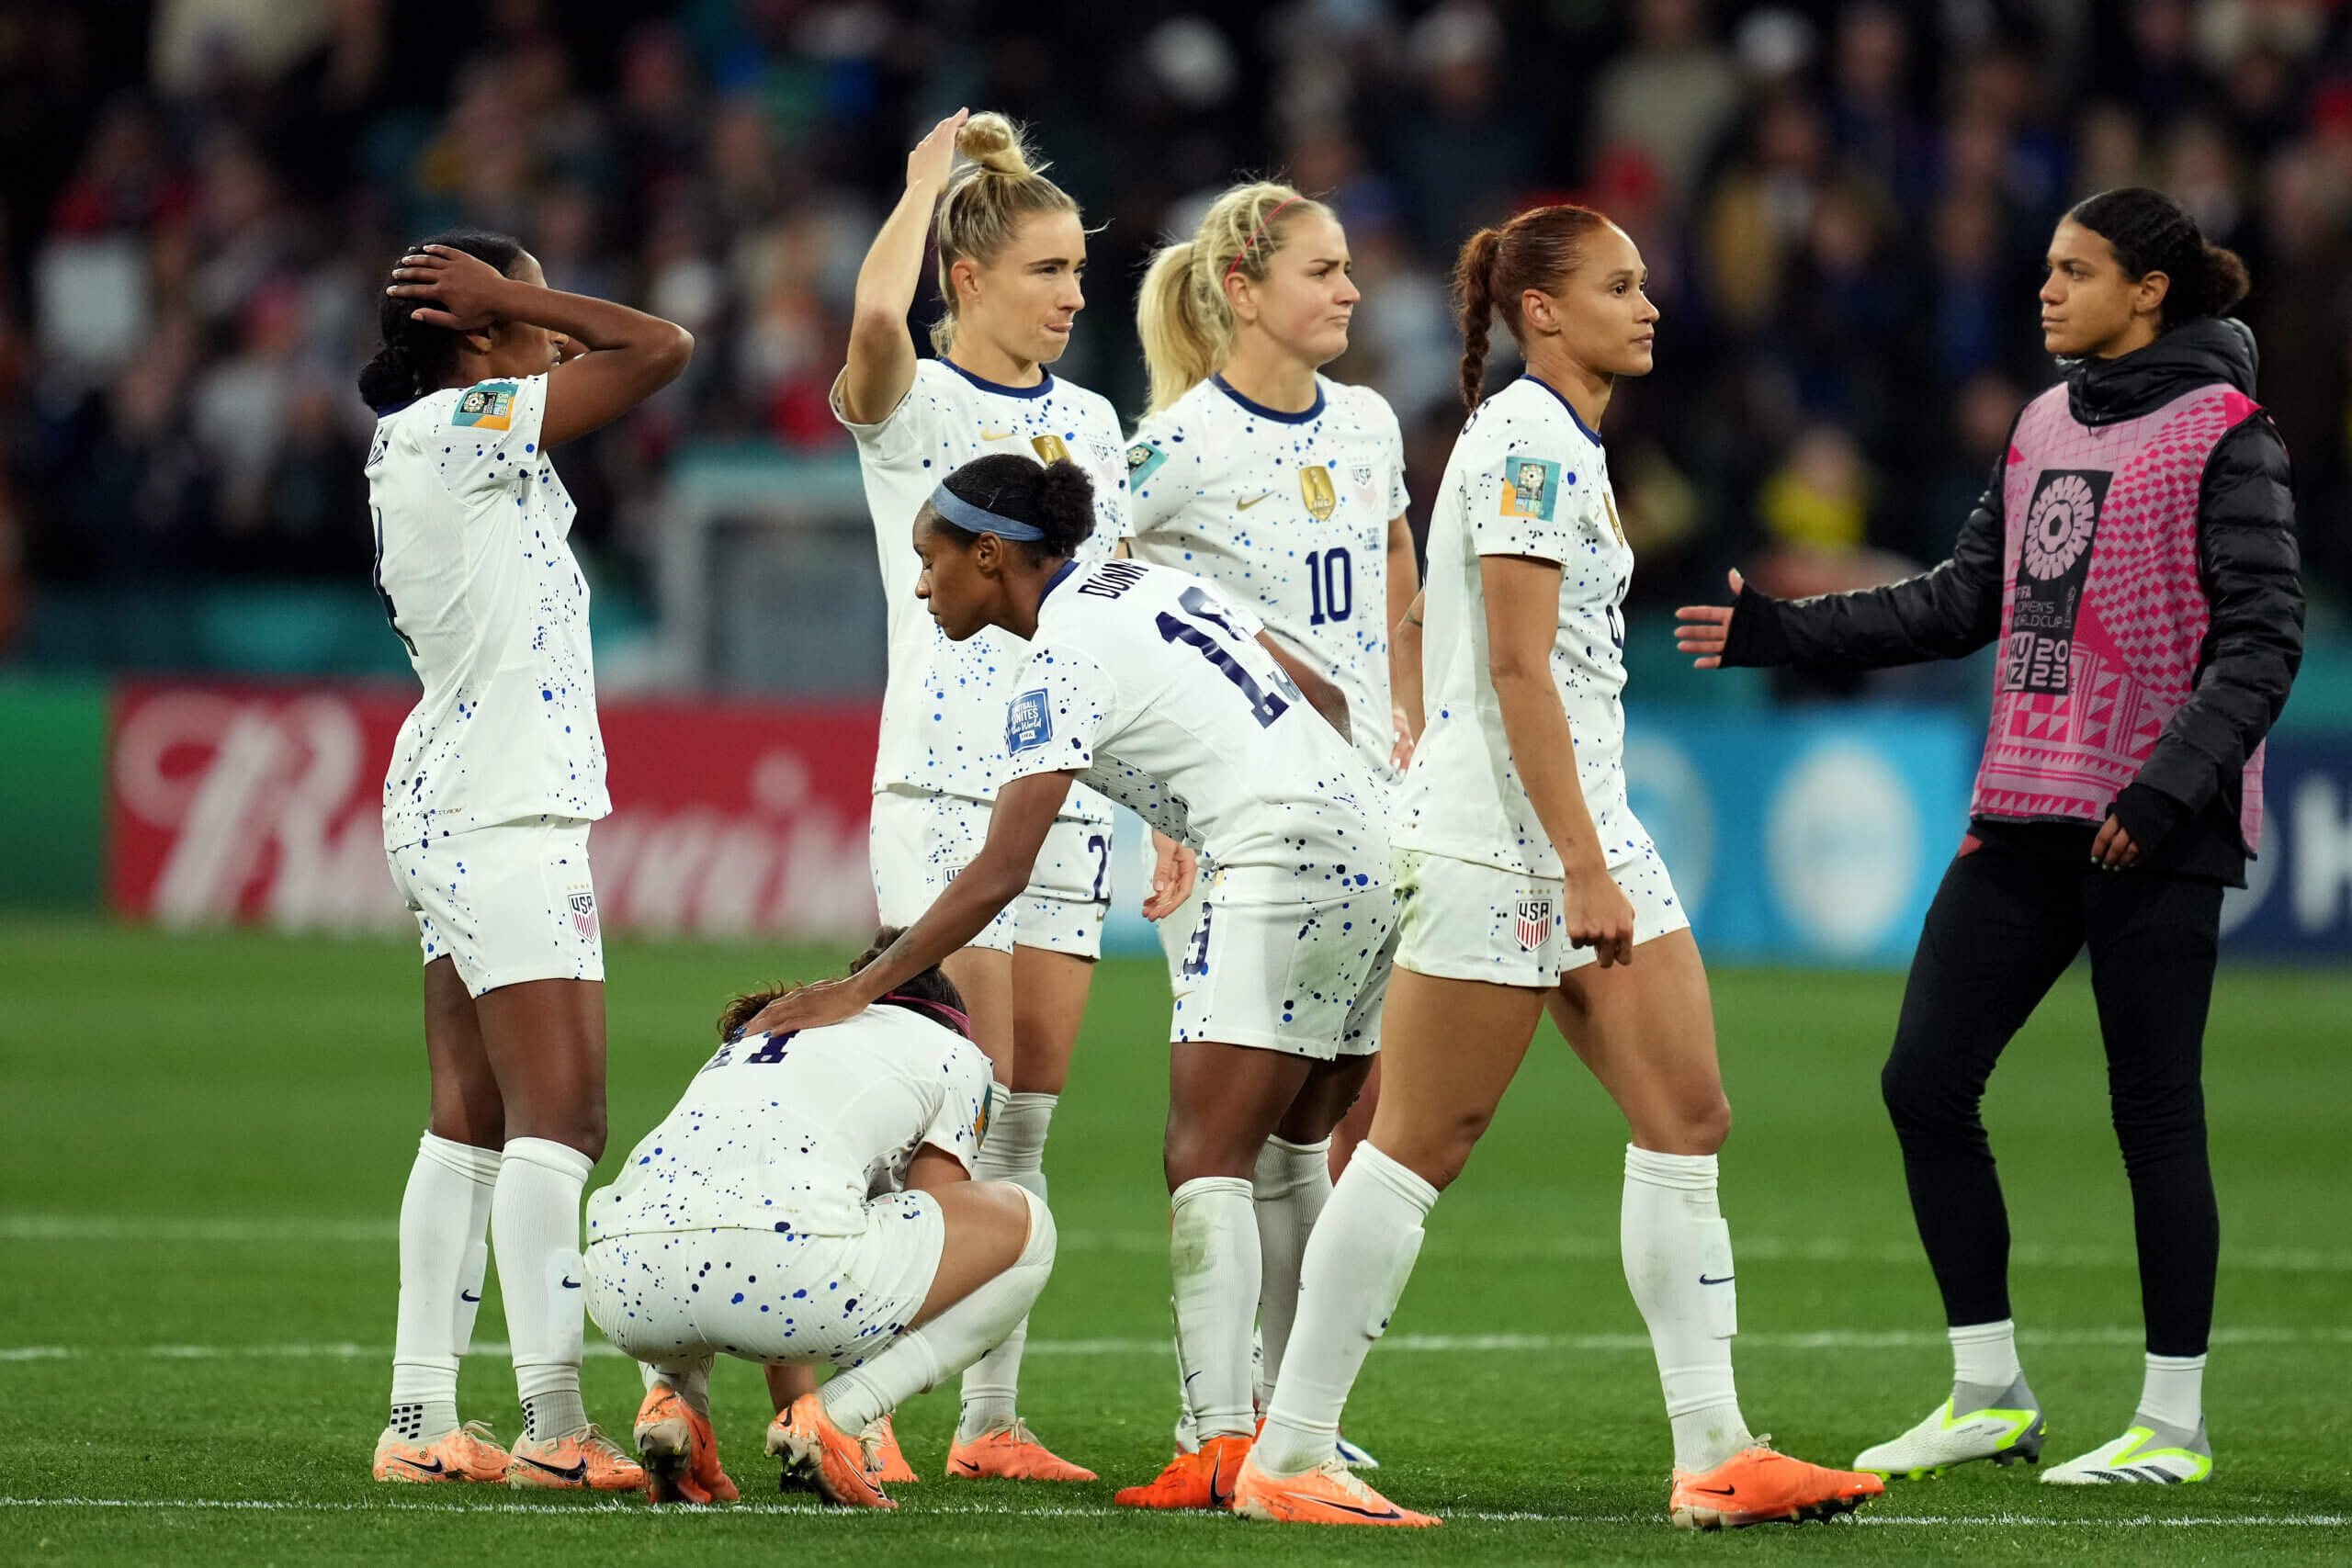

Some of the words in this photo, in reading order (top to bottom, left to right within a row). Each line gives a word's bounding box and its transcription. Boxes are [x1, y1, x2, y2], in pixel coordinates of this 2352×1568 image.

[1077, 558, 1149, 600] DUNN
[1306, 547, 1352, 626] 10
[2035, 637, 2069, 663] 20
[2030, 663, 2067, 689] 23
[1088, 833, 1113, 901] 2
[571, 896, 594, 914] USA
[1519, 902, 1549, 922] USA
